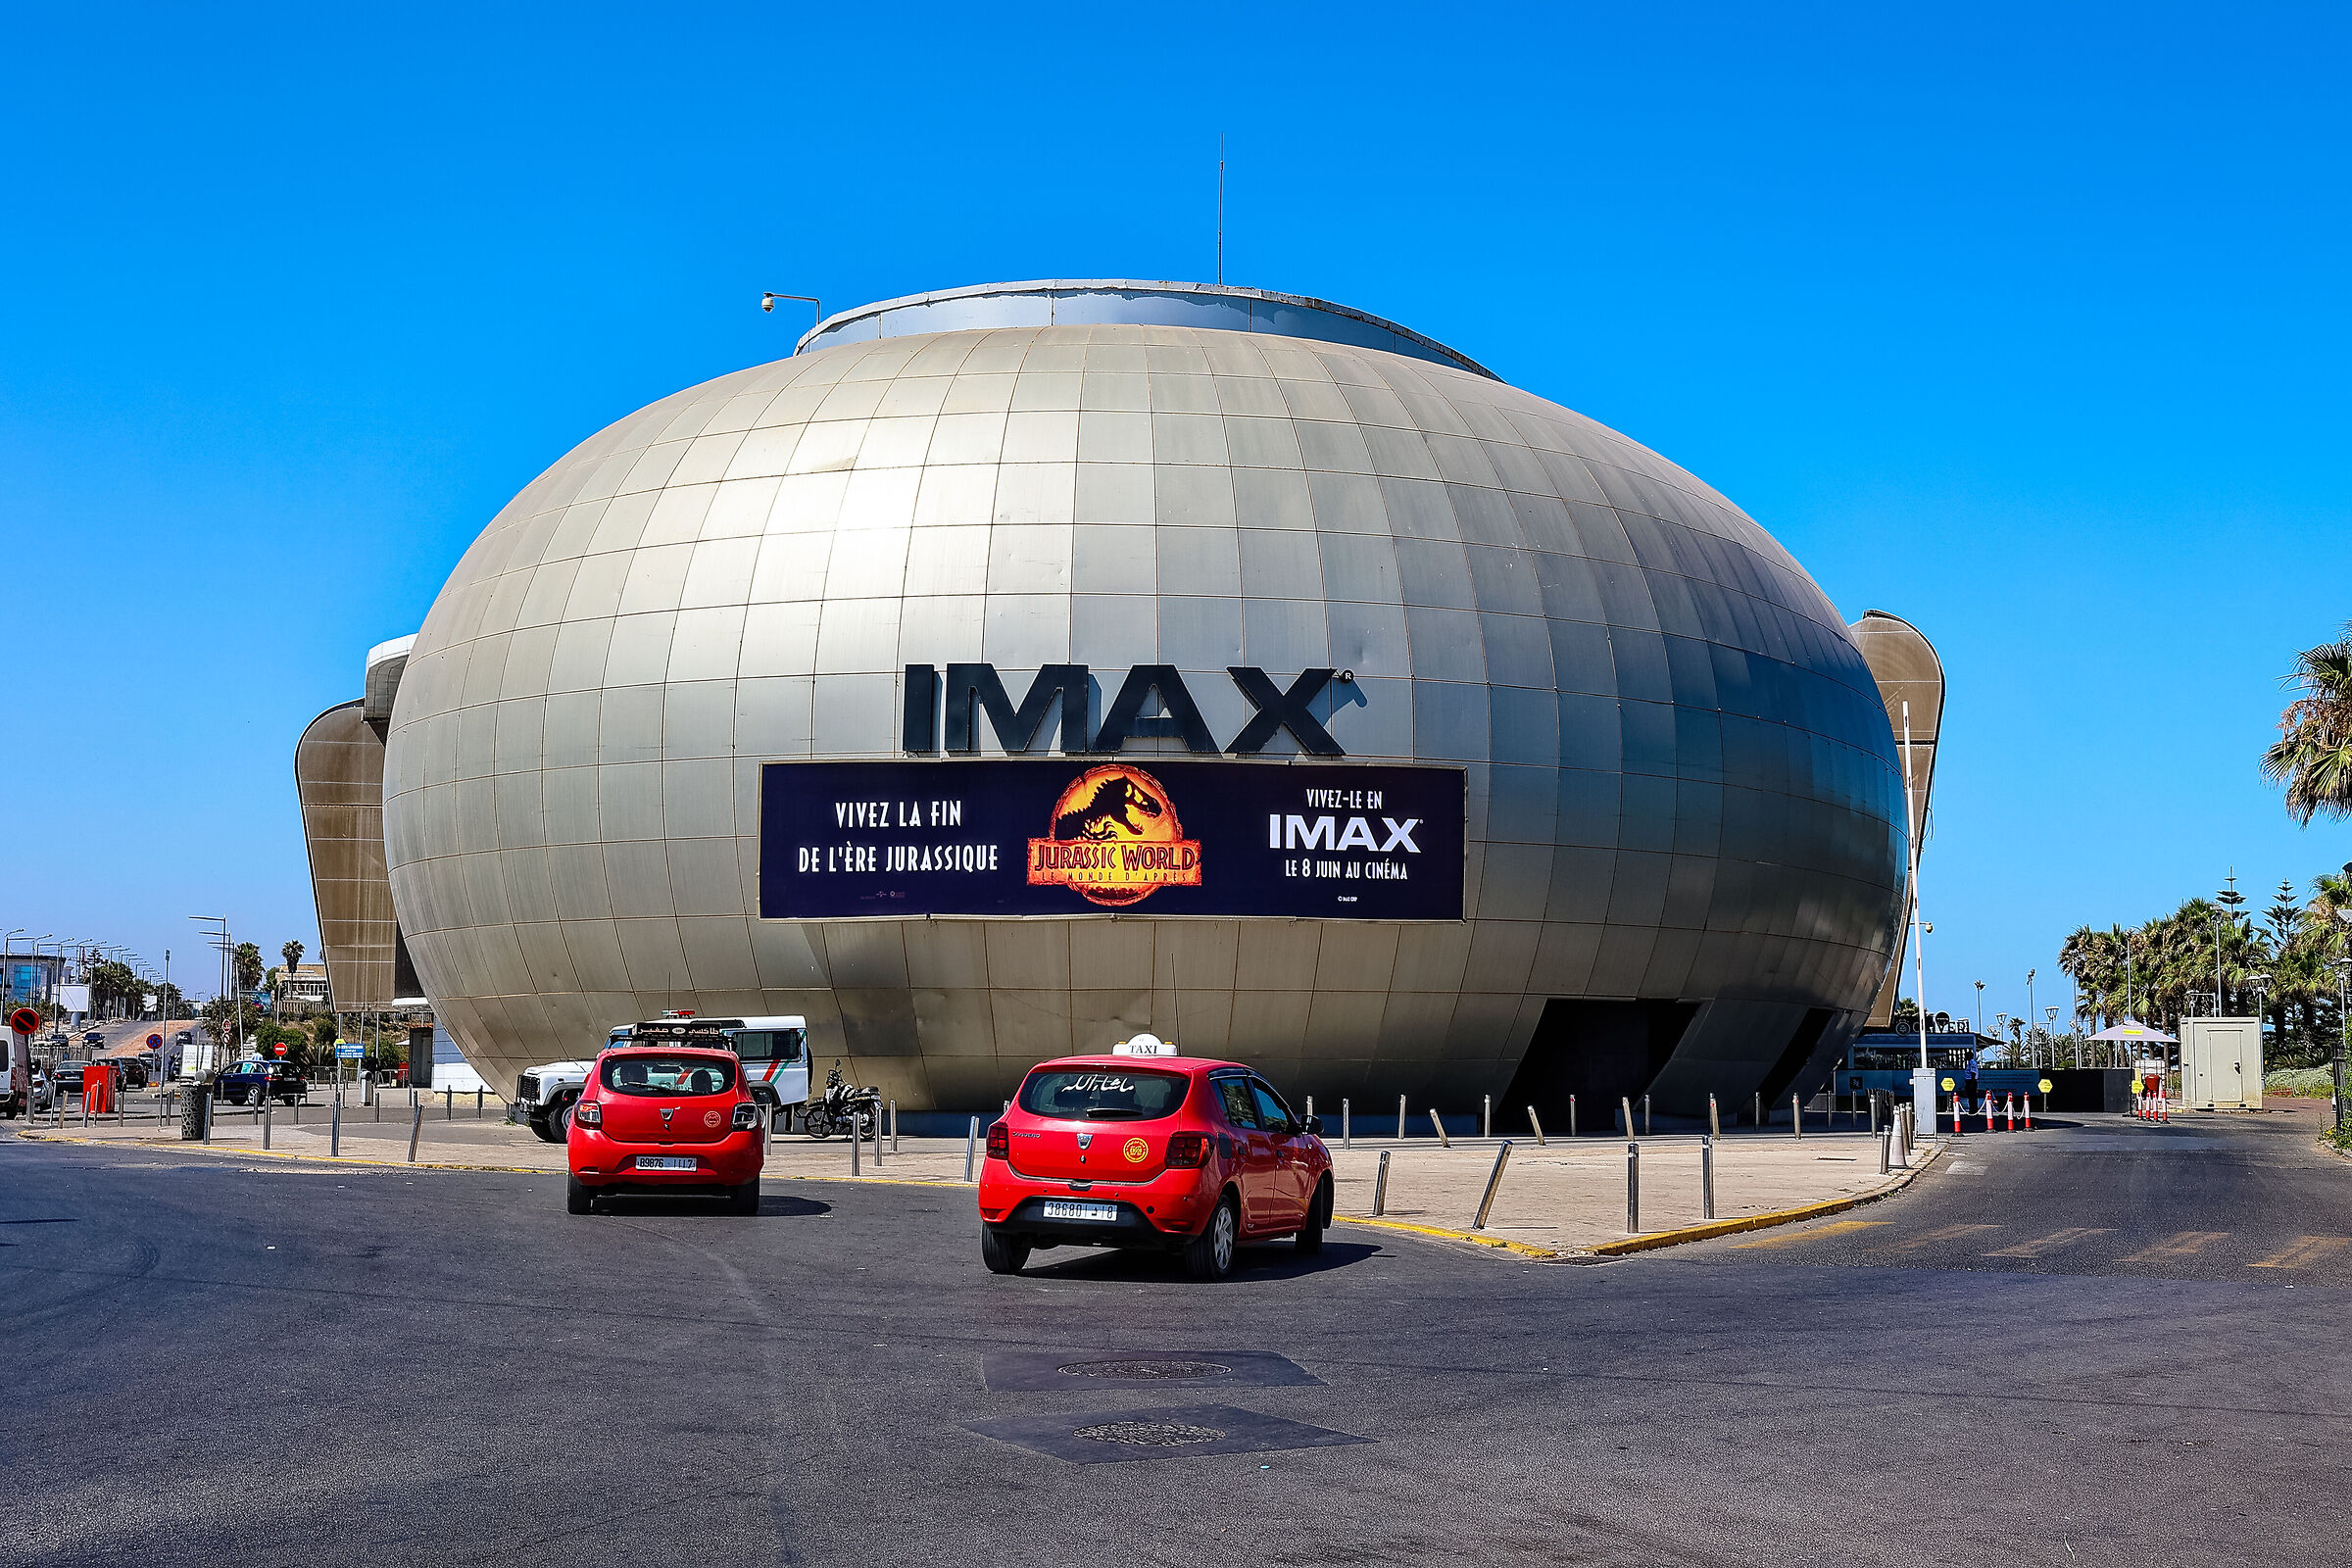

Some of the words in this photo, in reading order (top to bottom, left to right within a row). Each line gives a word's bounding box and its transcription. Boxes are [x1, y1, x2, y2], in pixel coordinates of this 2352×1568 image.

[1306, 788, 1362, 809] VIVEZ-LE
[1367, 791, 1383, 809] EN
[835, 802, 890, 828] VIVEZ
[899, 801, 921, 827] LA
[931, 800, 961, 826] FIN
[799, 847, 819, 872] DE
[828, 841, 876, 872] L'ÈRE
[886, 845, 998, 872] JURASSIQUE
[1035, 845, 1116, 871] JURASSIC
[1121, 845, 1196, 871] WORLD
[1042, 872, 1054, 881] LE
[1067, 872, 1112, 881] MONDE
[1125, 871, 1187, 882] D'APRÈS
[1285, 859, 1298, 877] LE
[1302, 858, 1311, 877] 8
[1315, 860, 1341, 878] JUIN
[1346, 861, 1360, 879] AU
[1365, 858, 1408, 880] CINÉMA
[1129, 1045, 1157, 1054] TAXI
